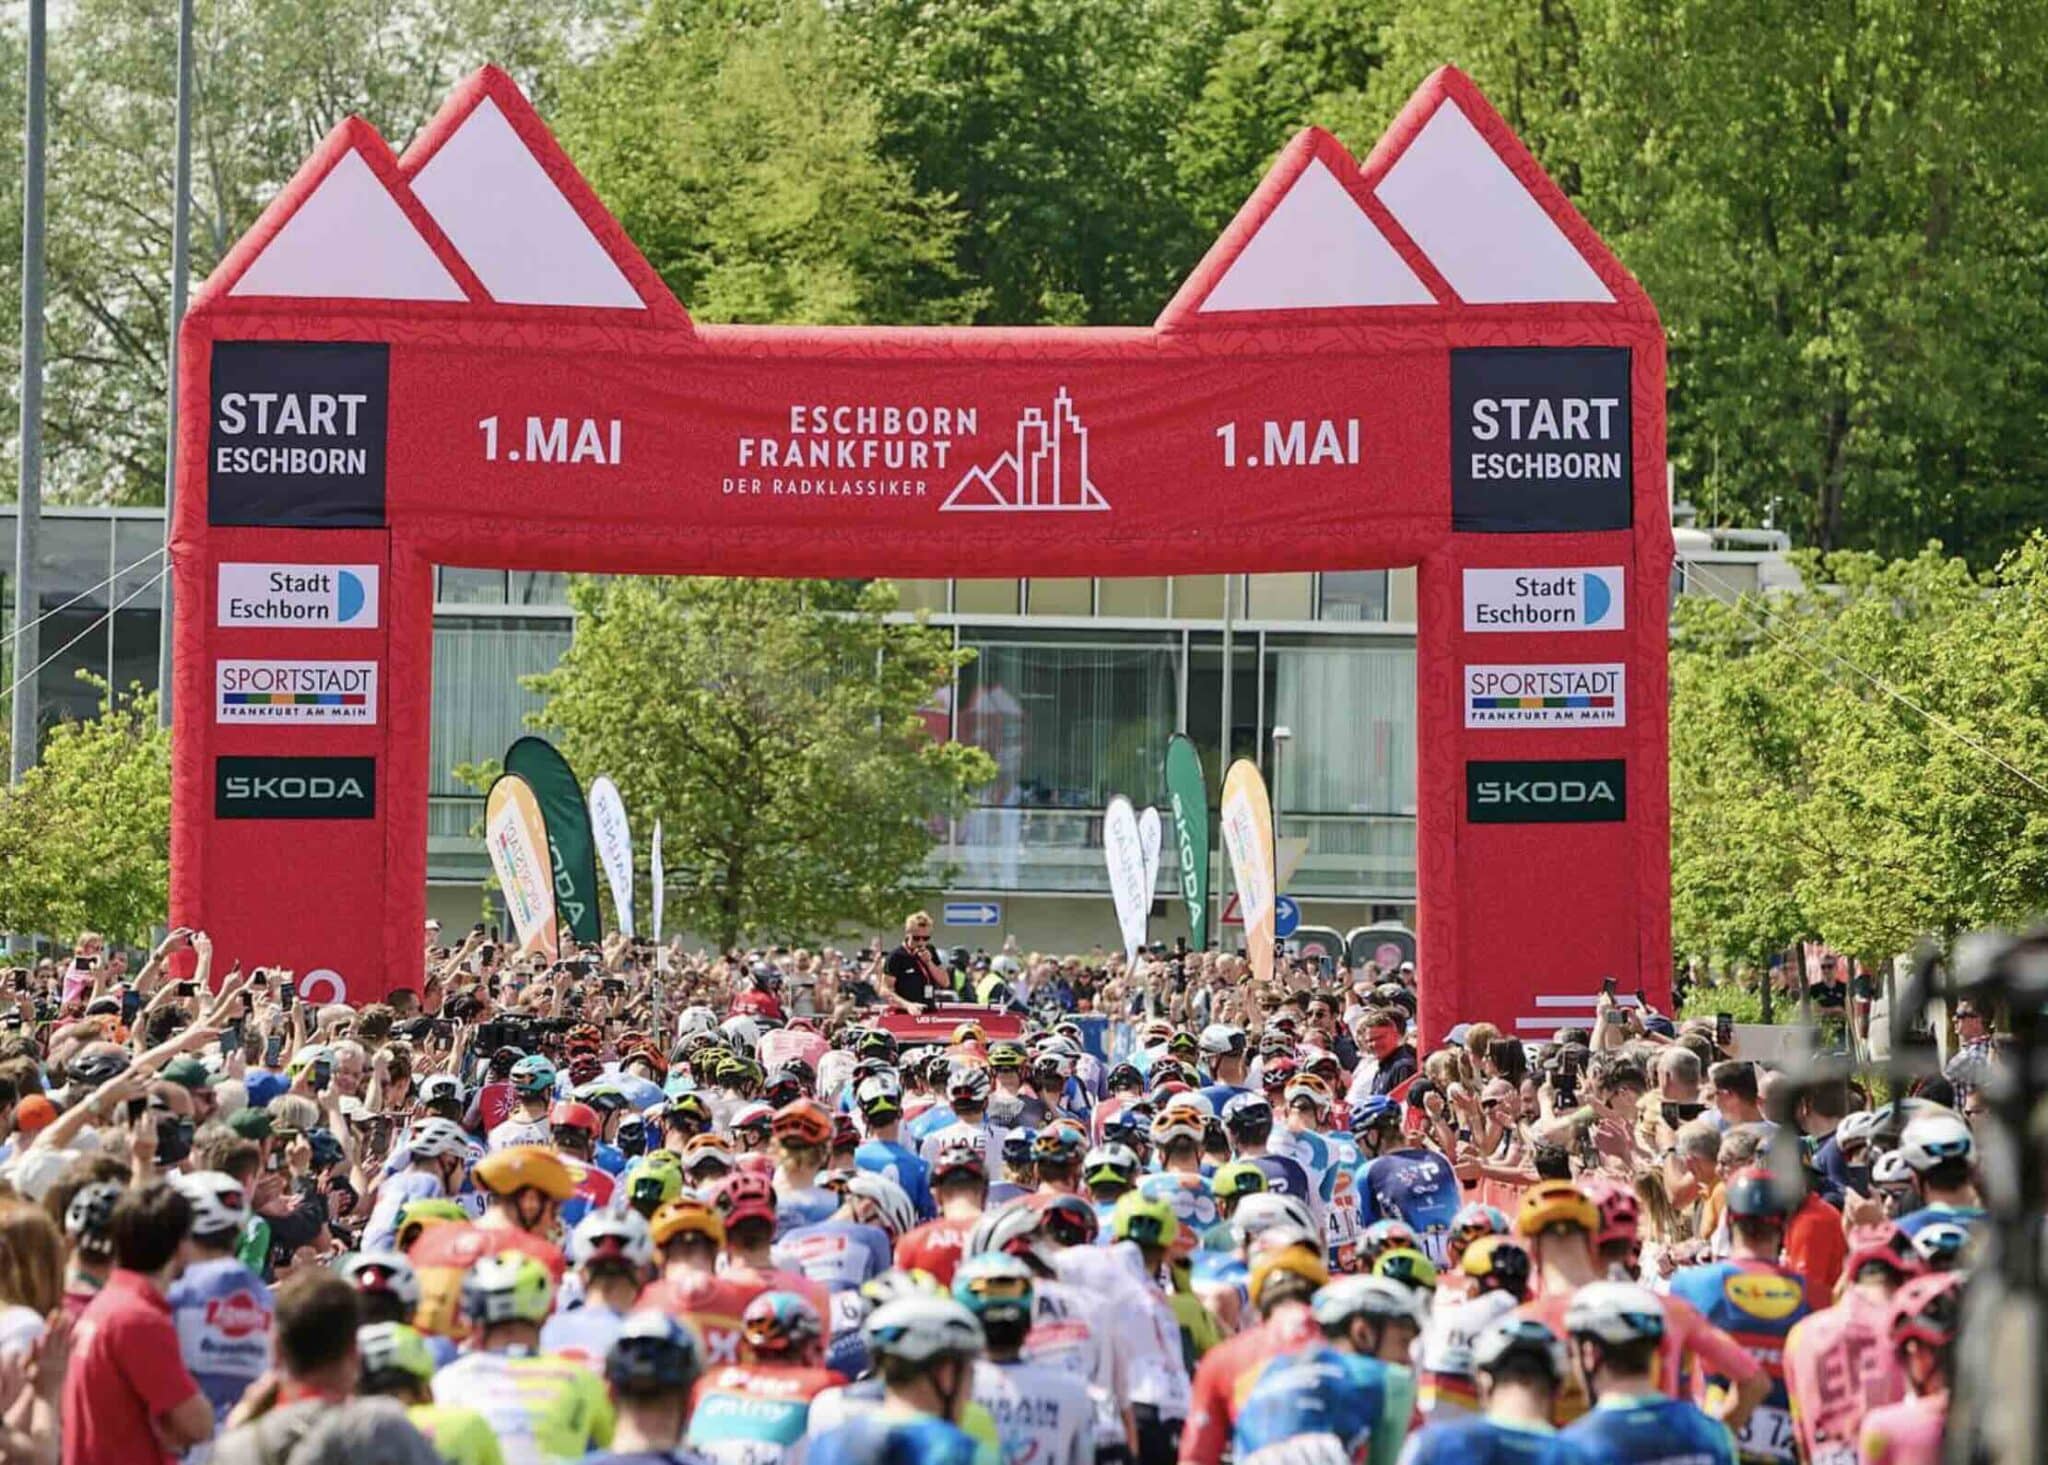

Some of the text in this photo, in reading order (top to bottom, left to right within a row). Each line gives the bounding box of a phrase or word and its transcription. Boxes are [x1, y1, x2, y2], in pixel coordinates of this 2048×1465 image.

[218, 391, 368, 437] START
[789, 404, 978, 437] ESCHBORN
[1470, 397, 1620, 442] START
[477, 414, 623, 466] 1.MAI
[1215, 417, 1360, 468] 1.MAI
[216, 446, 367, 476] ESCHBORN
[738, 437, 953, 470] FRANKFURT
[1470, 451, 1622, 480] ESCHBORN
[721, 477, 928, 498] DER RADKLASSIKER
[269, 571, 332, 594] Stadt
[1514, 575, 1577, 598] Stadt
[229, 597, 331, 622] Eschborn
[1475, 602, 1577, 625] Eschborn
[221, 667, 373, 693] SPORTSTADT
[1470, 670, 1620, 696] SPORTSTADT
[222, 706, 368, 717] FRANKFURT AM MAIN
[1471, 709, 1617, 721] FRANKFURT AM MAIN
